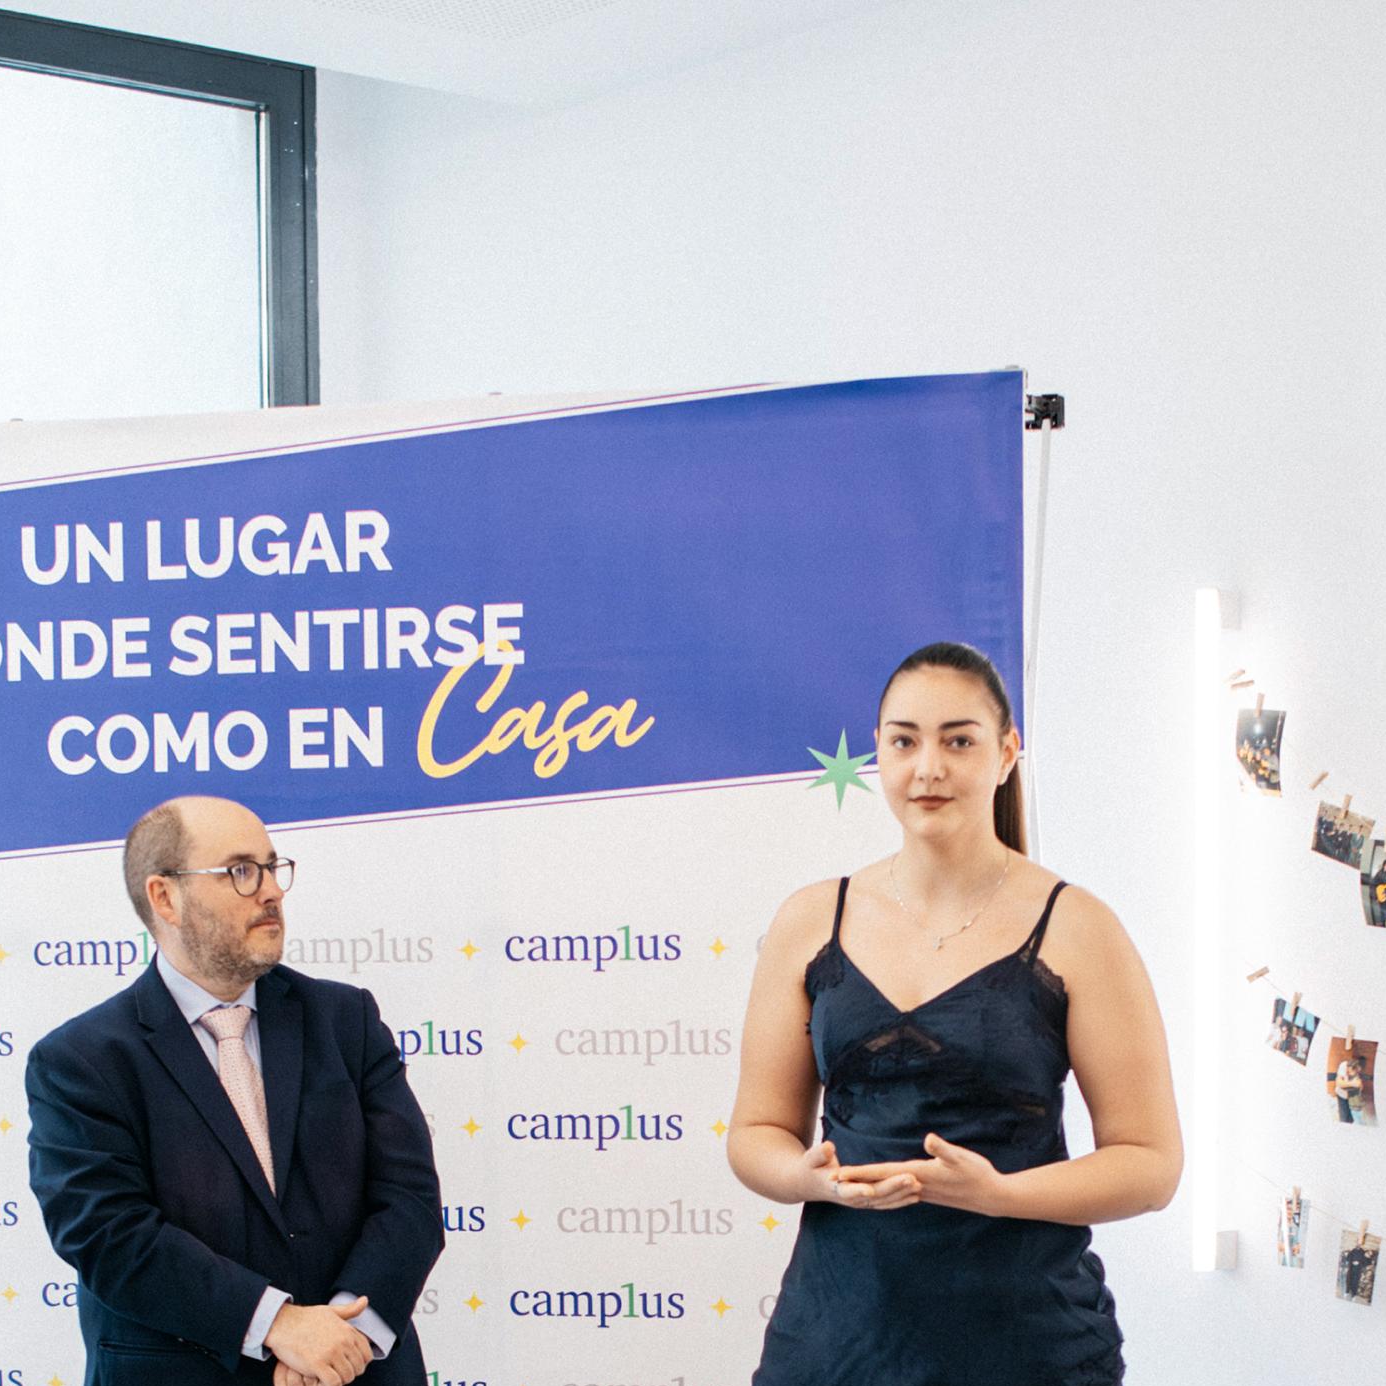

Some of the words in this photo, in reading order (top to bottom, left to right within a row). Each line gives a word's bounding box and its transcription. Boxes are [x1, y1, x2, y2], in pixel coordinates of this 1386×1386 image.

[22, 523, 124, 585] UN
[147, 511, 392, 580] LUGAR
[170, 603, 525, 676] SENTIRSE
[48, 711, 268, 775] COMO
[290, 707, 383, 768] EN
[417, 639, 655, 778] Casa
[33, 931, 150, 976] campl
[286, 928, 434, 974] amplus
[504, 925, 682, 973] camplus
[396, 1020, 483, 1066] plus
[555, 1019, 731, 1066] camplus
[507, 1104, 683, 1152] camplus
[557, 1199, 733, 1246] camplus
[509, 1282, 686, 1329] camplus
